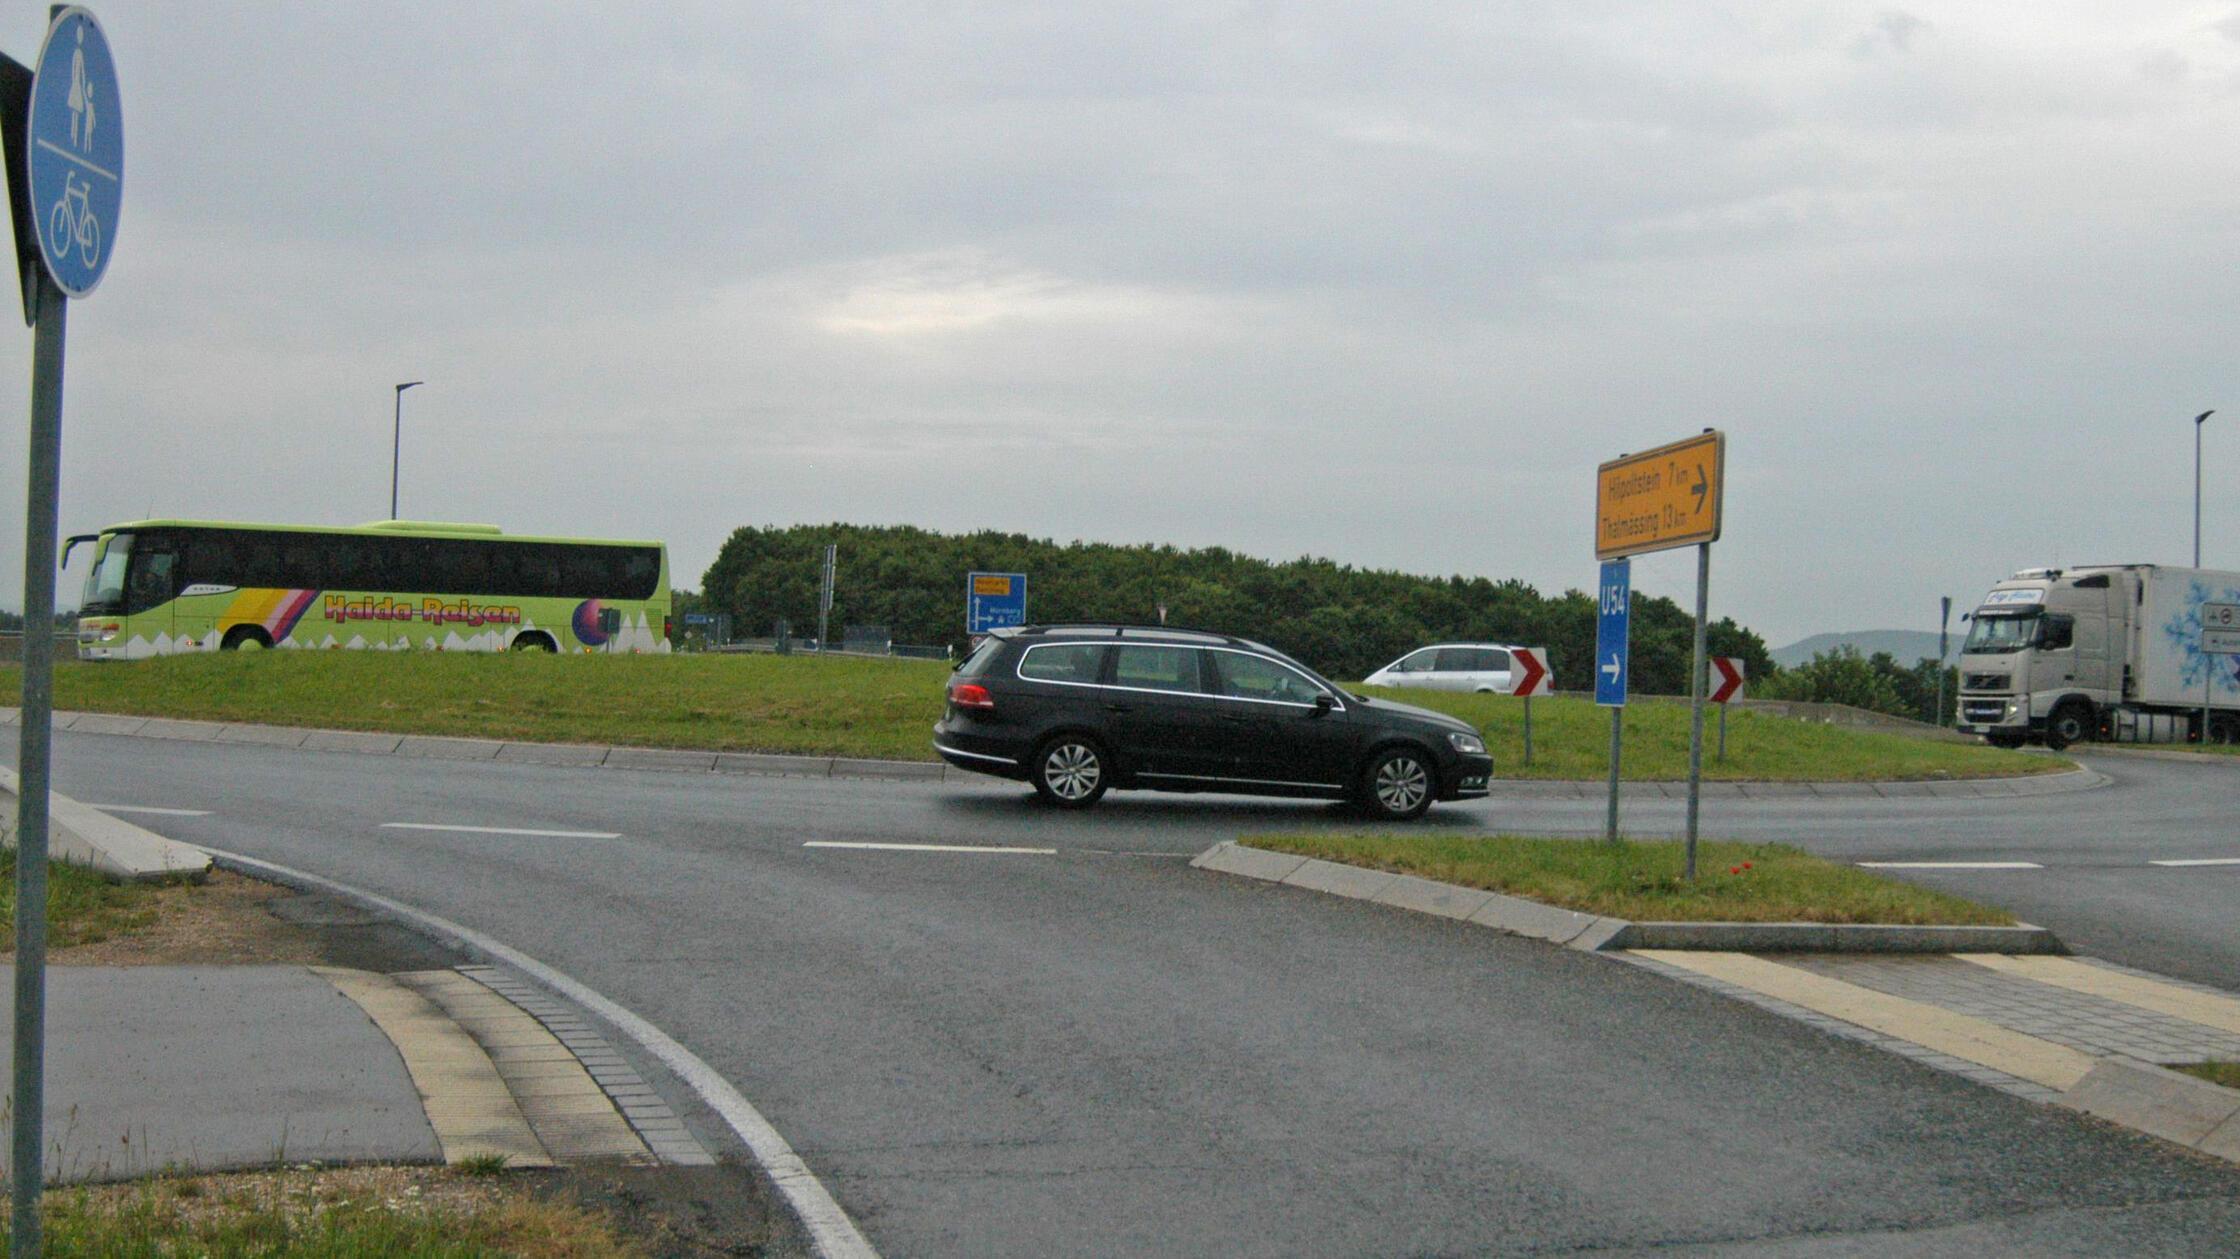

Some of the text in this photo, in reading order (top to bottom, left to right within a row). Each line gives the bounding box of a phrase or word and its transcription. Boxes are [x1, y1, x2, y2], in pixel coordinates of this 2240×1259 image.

[1668, 461, 1677, 488] 7
[1676, 467, 1689, 487] km
[1663, 503, 1674, 529] 13
[1674, 510, 1687, 528] km
[324, 595, 520, 627] Haida-Reisen
[1601, 584, 1626, 615] U54
